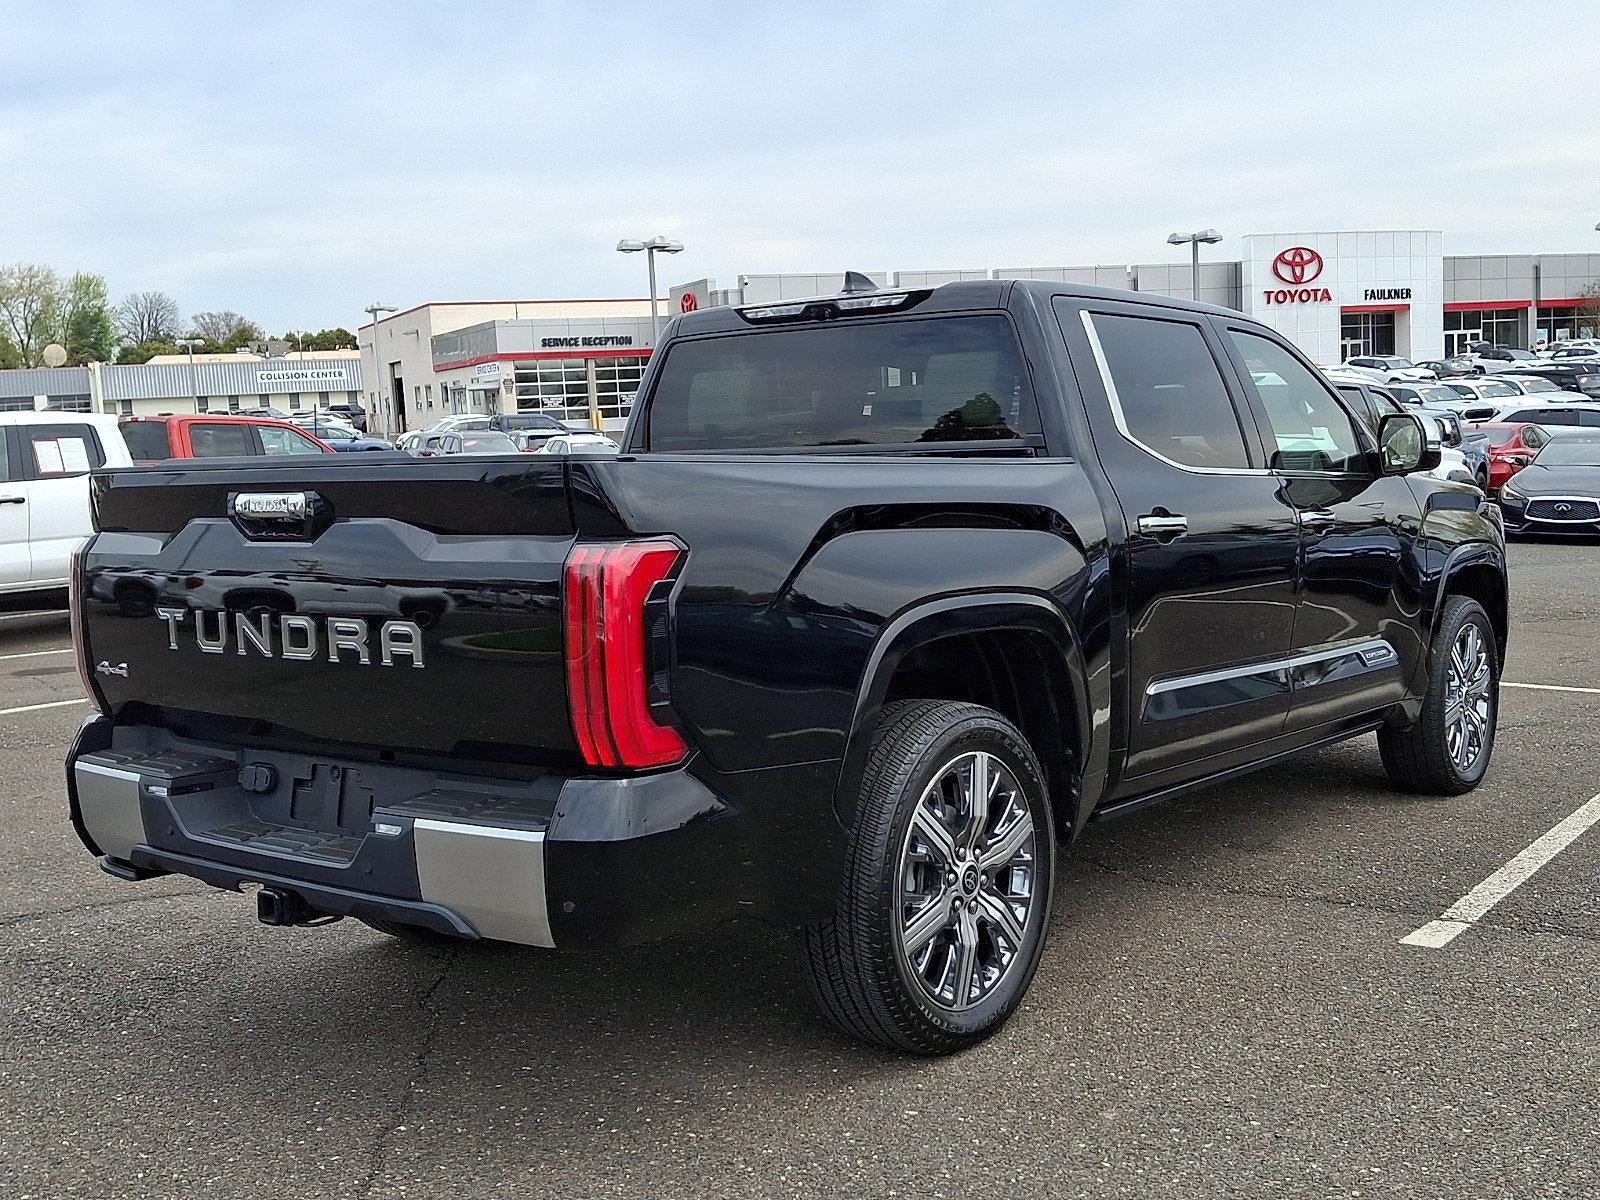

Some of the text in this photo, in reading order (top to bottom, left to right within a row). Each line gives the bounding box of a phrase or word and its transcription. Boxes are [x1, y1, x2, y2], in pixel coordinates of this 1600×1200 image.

[1264, 288, 1332, 305] TOYOTA
[1364, 288, 1412, 301] FAULKNER
[541, 335, 632, 347] SERVICE RECEPTION
[260, 371, 344, 380] COLLISION CENTER
[154, 606, 425, 669] TUNDRA
